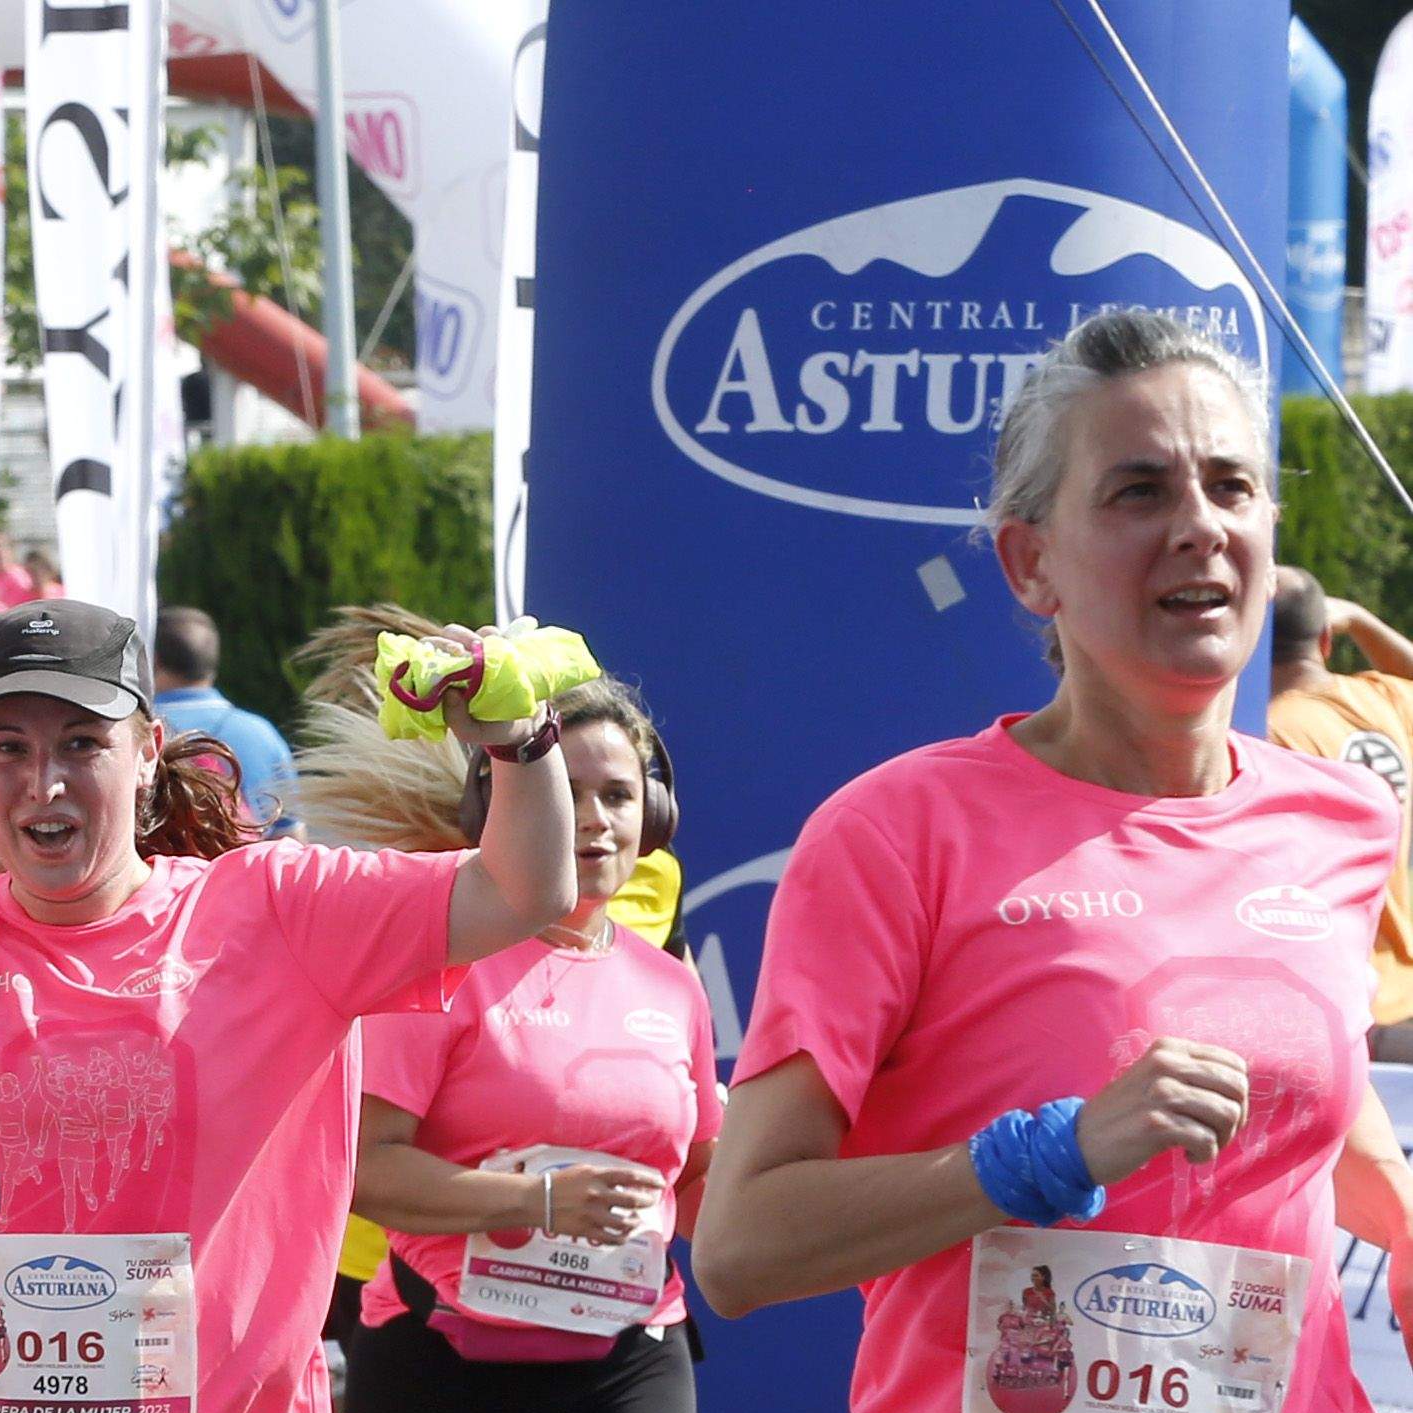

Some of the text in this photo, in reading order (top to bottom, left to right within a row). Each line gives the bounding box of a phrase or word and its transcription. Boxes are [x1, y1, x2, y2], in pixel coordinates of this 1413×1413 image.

[811, 301, 1044, 330] CENTRAL
[998, 889, 1143, 924] OYSHO
[548, 1250, 590, 1271] 4968
[125, 1267, 173, 1280] SUMA
[12, 1275, 109, 1296] ASTURIANA
[1231, 1281, 1242, 1290] TU
[1084, 1285, 1206, 1323] ASTURIANA
[1227, 1292, 1283, 1314] SUMA
[17, 1331, 105, 1363] 016
[33, 1375, 88, 1395] 4978
[1087, 1359, 1189, 1408] 016
